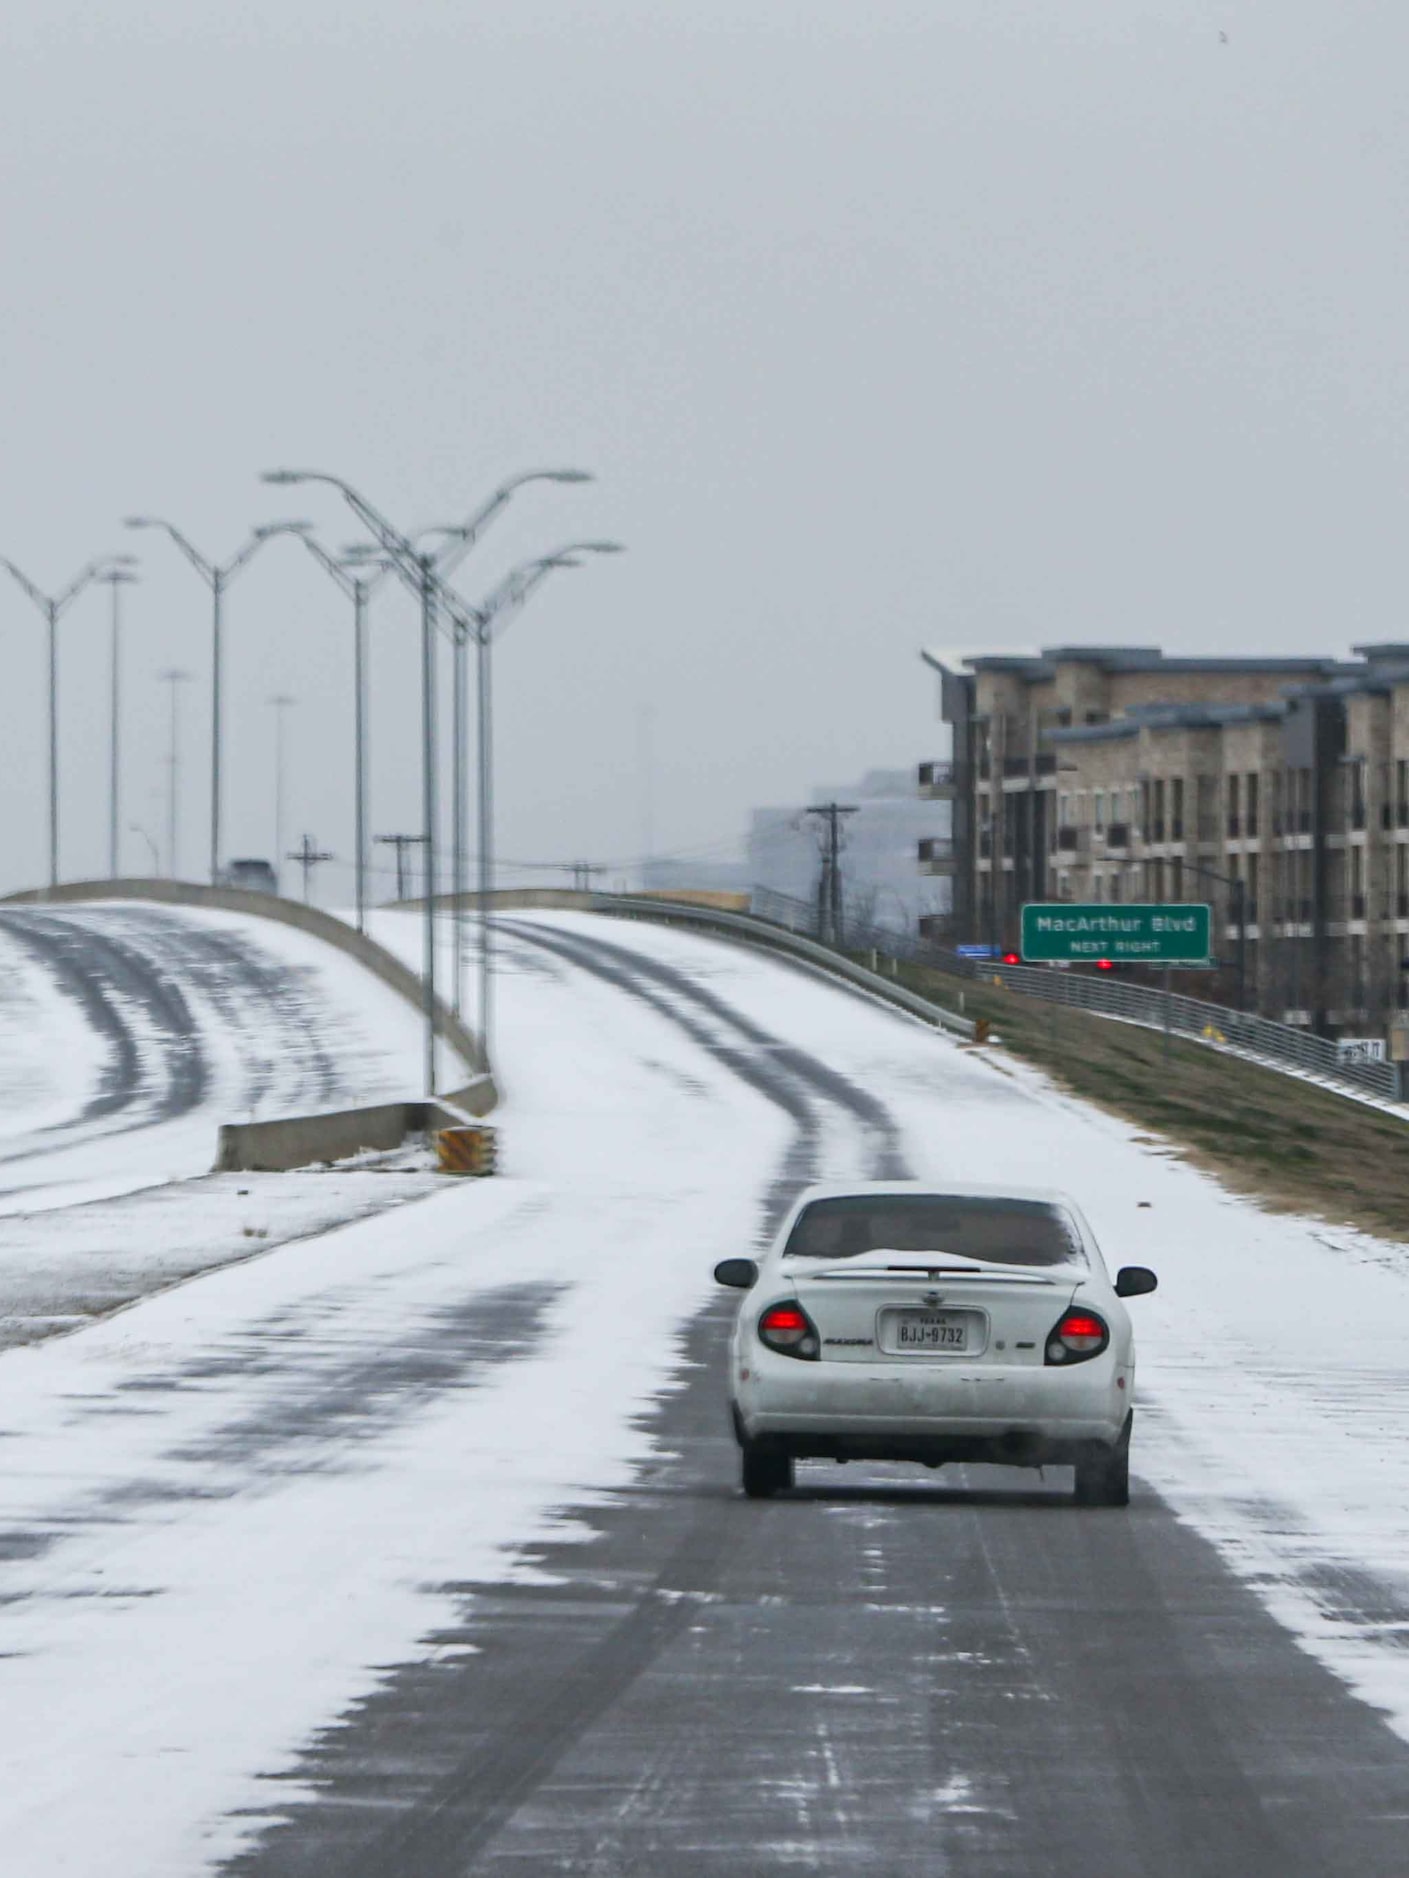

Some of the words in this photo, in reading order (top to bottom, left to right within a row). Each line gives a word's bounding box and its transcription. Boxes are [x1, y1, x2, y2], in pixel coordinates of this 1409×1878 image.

[1037, 916, 1142, 932] MacArthur
[1151, 916, 1197, 932] Blvd
[1070, 941, 1108, 953] NEXT
[1115, 941, 1161, 953] RIGHT
